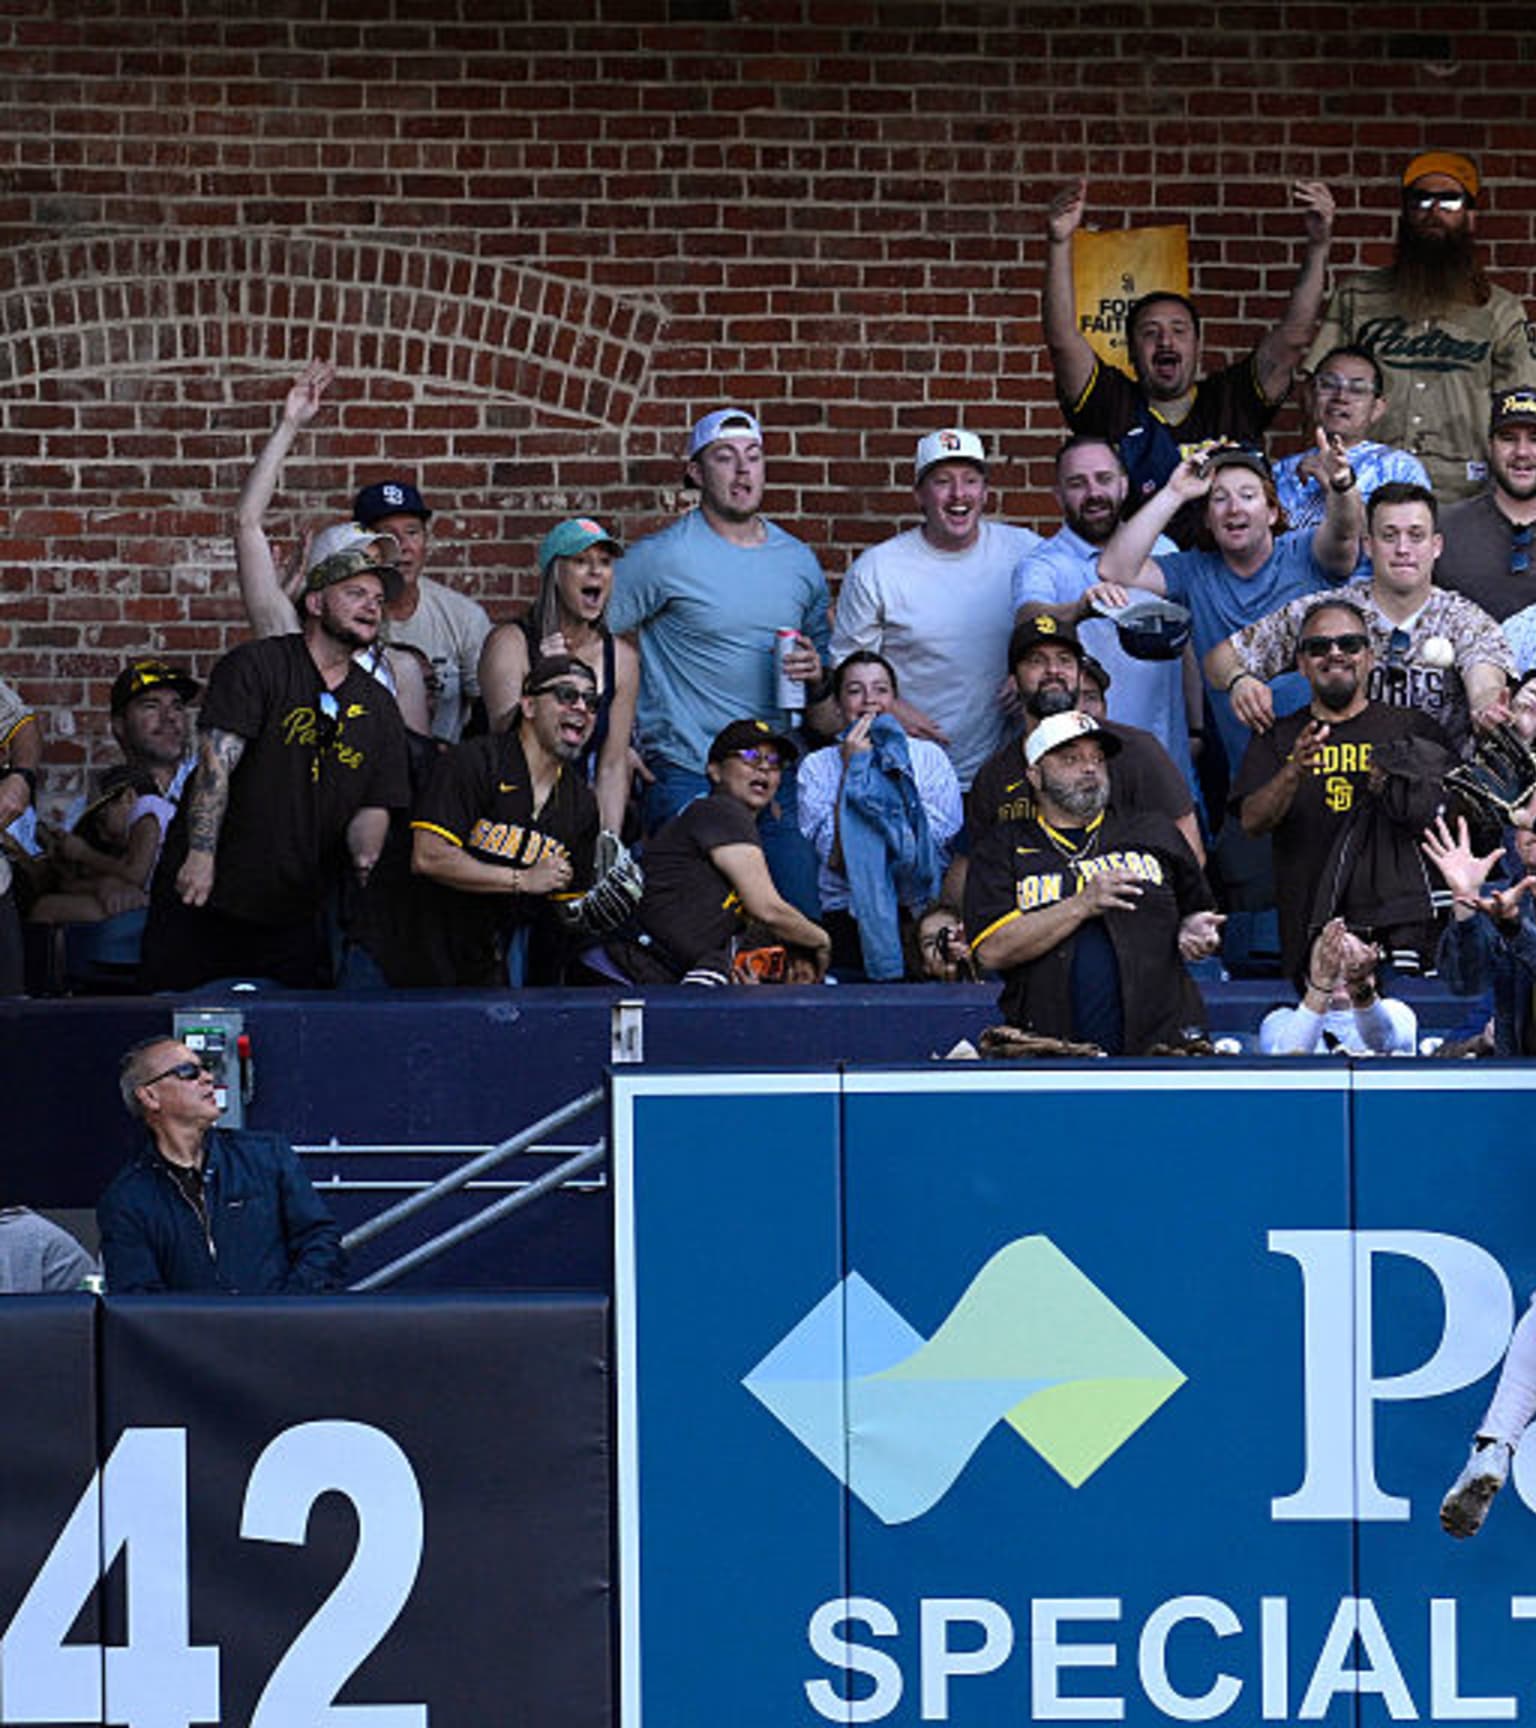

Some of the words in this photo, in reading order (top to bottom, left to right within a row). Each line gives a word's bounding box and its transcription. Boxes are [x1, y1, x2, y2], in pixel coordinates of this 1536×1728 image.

[1356, 317, 1490, 363] Padres
[1368, 666, 1445, 709] DRES
[1016, 874, 1063, 911] AN
